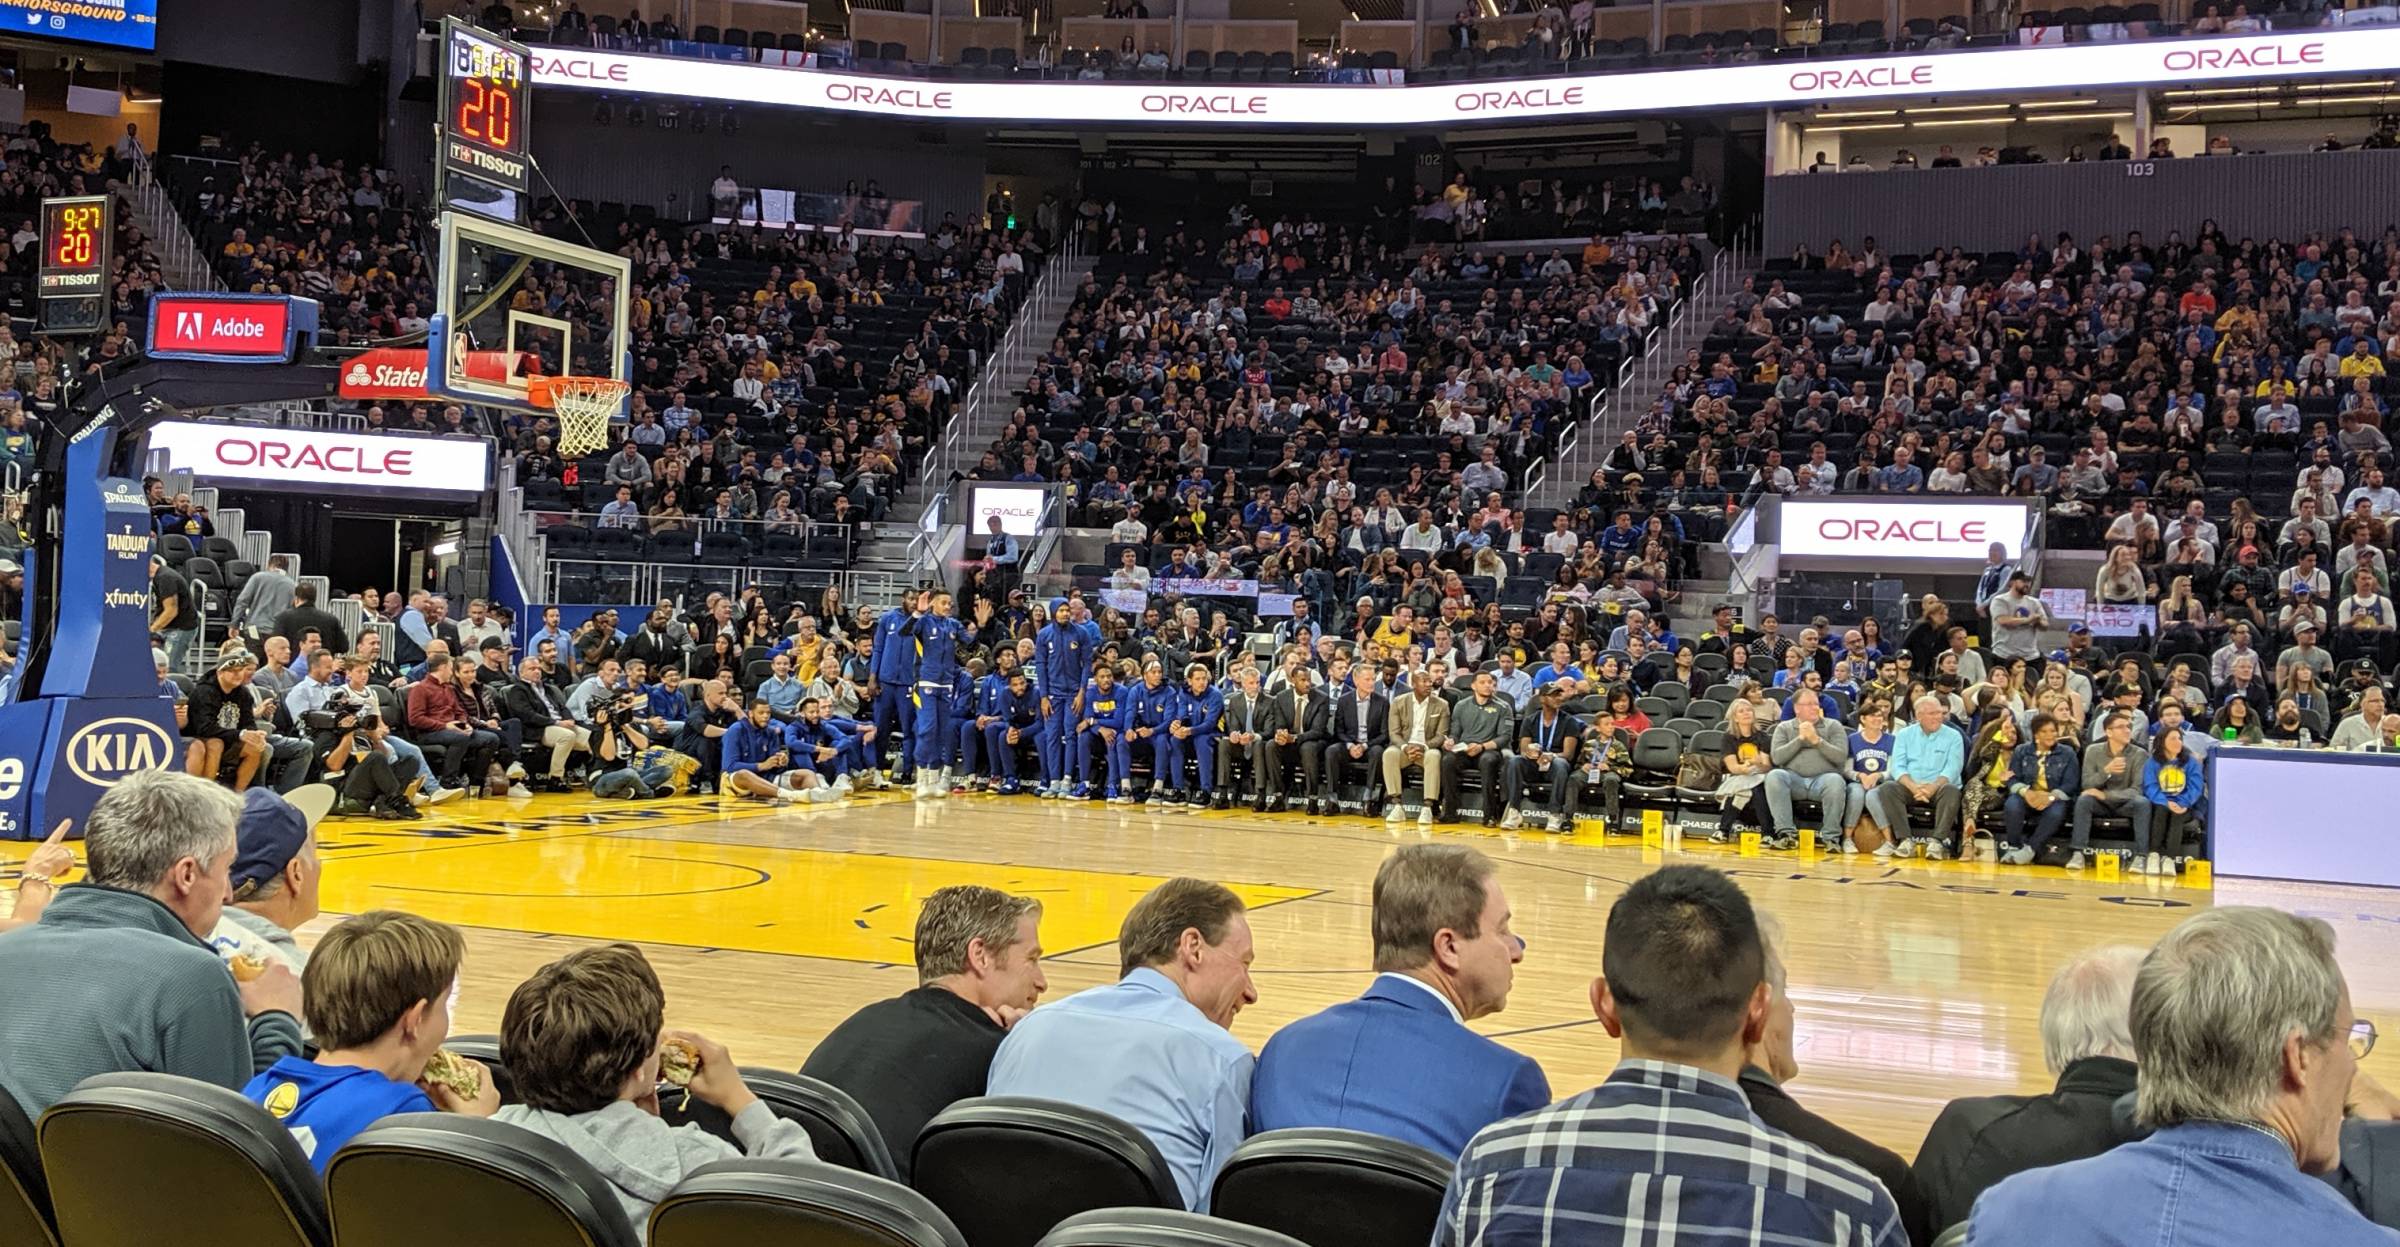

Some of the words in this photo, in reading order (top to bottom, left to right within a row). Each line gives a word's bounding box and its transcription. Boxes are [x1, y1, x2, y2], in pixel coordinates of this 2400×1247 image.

[530, 55, 629, 82] RACLE
[2163, 43, 2325, 71] ORACLE
[1789, 64, 1934, 91] ORACLE
[826, 83, 953, 110] ORACLE
[1141, 95, 1268, 114] ORACLE
[1455, 86, 1584, 112] ORACLE
[461, 78, 510, 146] 20
[472, 150, 524, 179] TISSOT
[1420, 153, 1440, 166] 102
[2126, 163, 2154, 176] 103
[64, 207, 100, 232] 9:27
[60, 233, 91, 264] 20
[59, 274, 100, 286] TISSOT
[211, 317, 265, 338] Adobe
[70, 403, 116, 444] SPALDING
[215, 438, 413, 476] ORACLE
[104, 490, 148, 506] SPALDING
[982, 507, 1035, 517] ORACLE
[106, 533, 149, 552] TANDUAY
[1818, 518, 1987, 543] ORACLE
[118, 551, 137, 560] RUM
[105, 588, 148, 609] xfinity
[86, 733, 156, 772] KIA
[1625, 815, 1644, 825] CHA
[1680, 819, 1714, 830] CHASE
